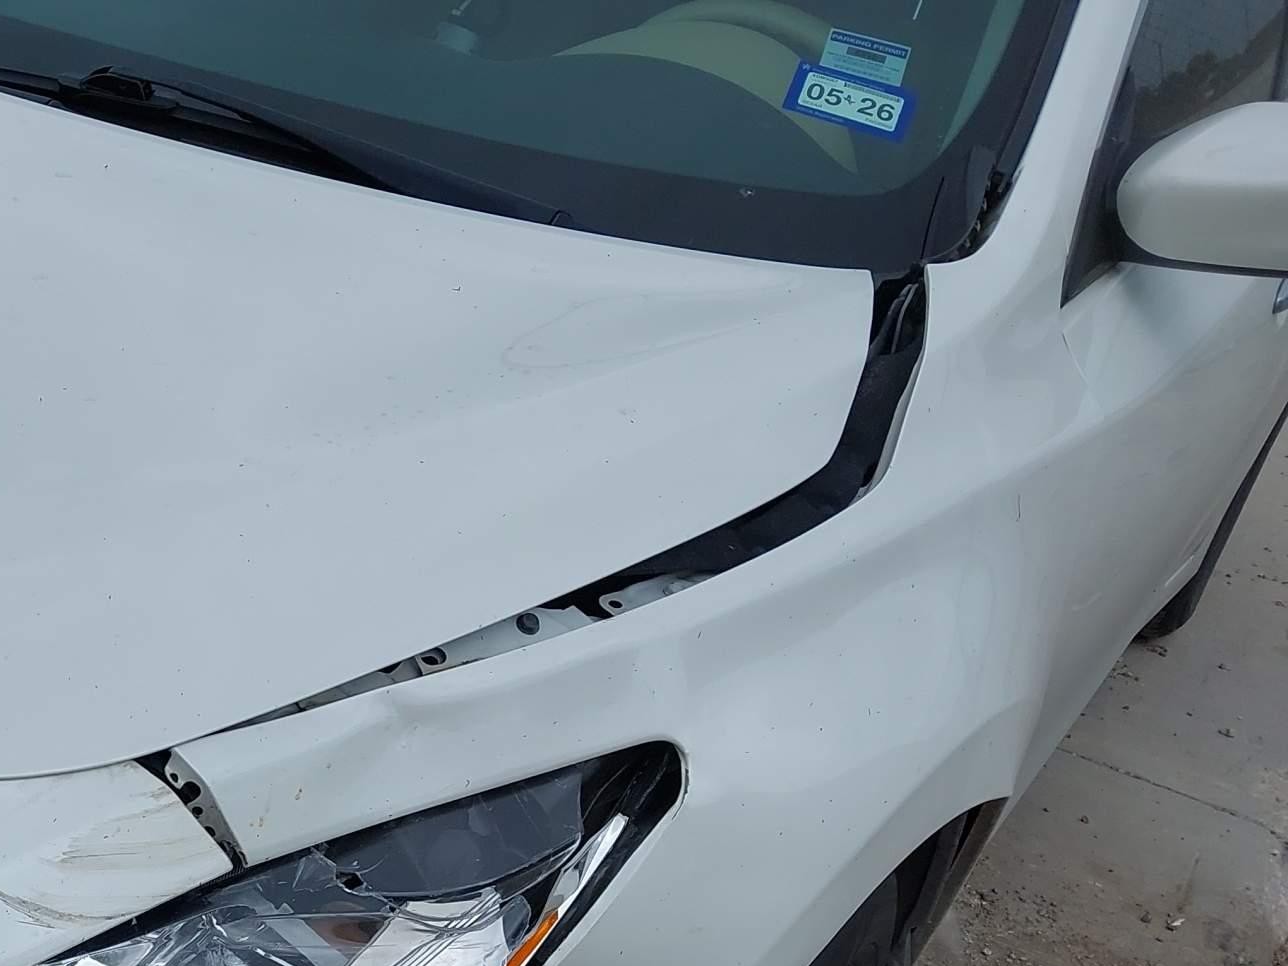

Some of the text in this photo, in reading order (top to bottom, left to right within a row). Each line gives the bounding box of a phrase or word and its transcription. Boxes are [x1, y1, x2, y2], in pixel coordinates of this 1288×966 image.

[832, 33, 907, 57] PARKING PERMIT
[806, 83, 844, 106] 05
[857, 98, 895, 122] 26
